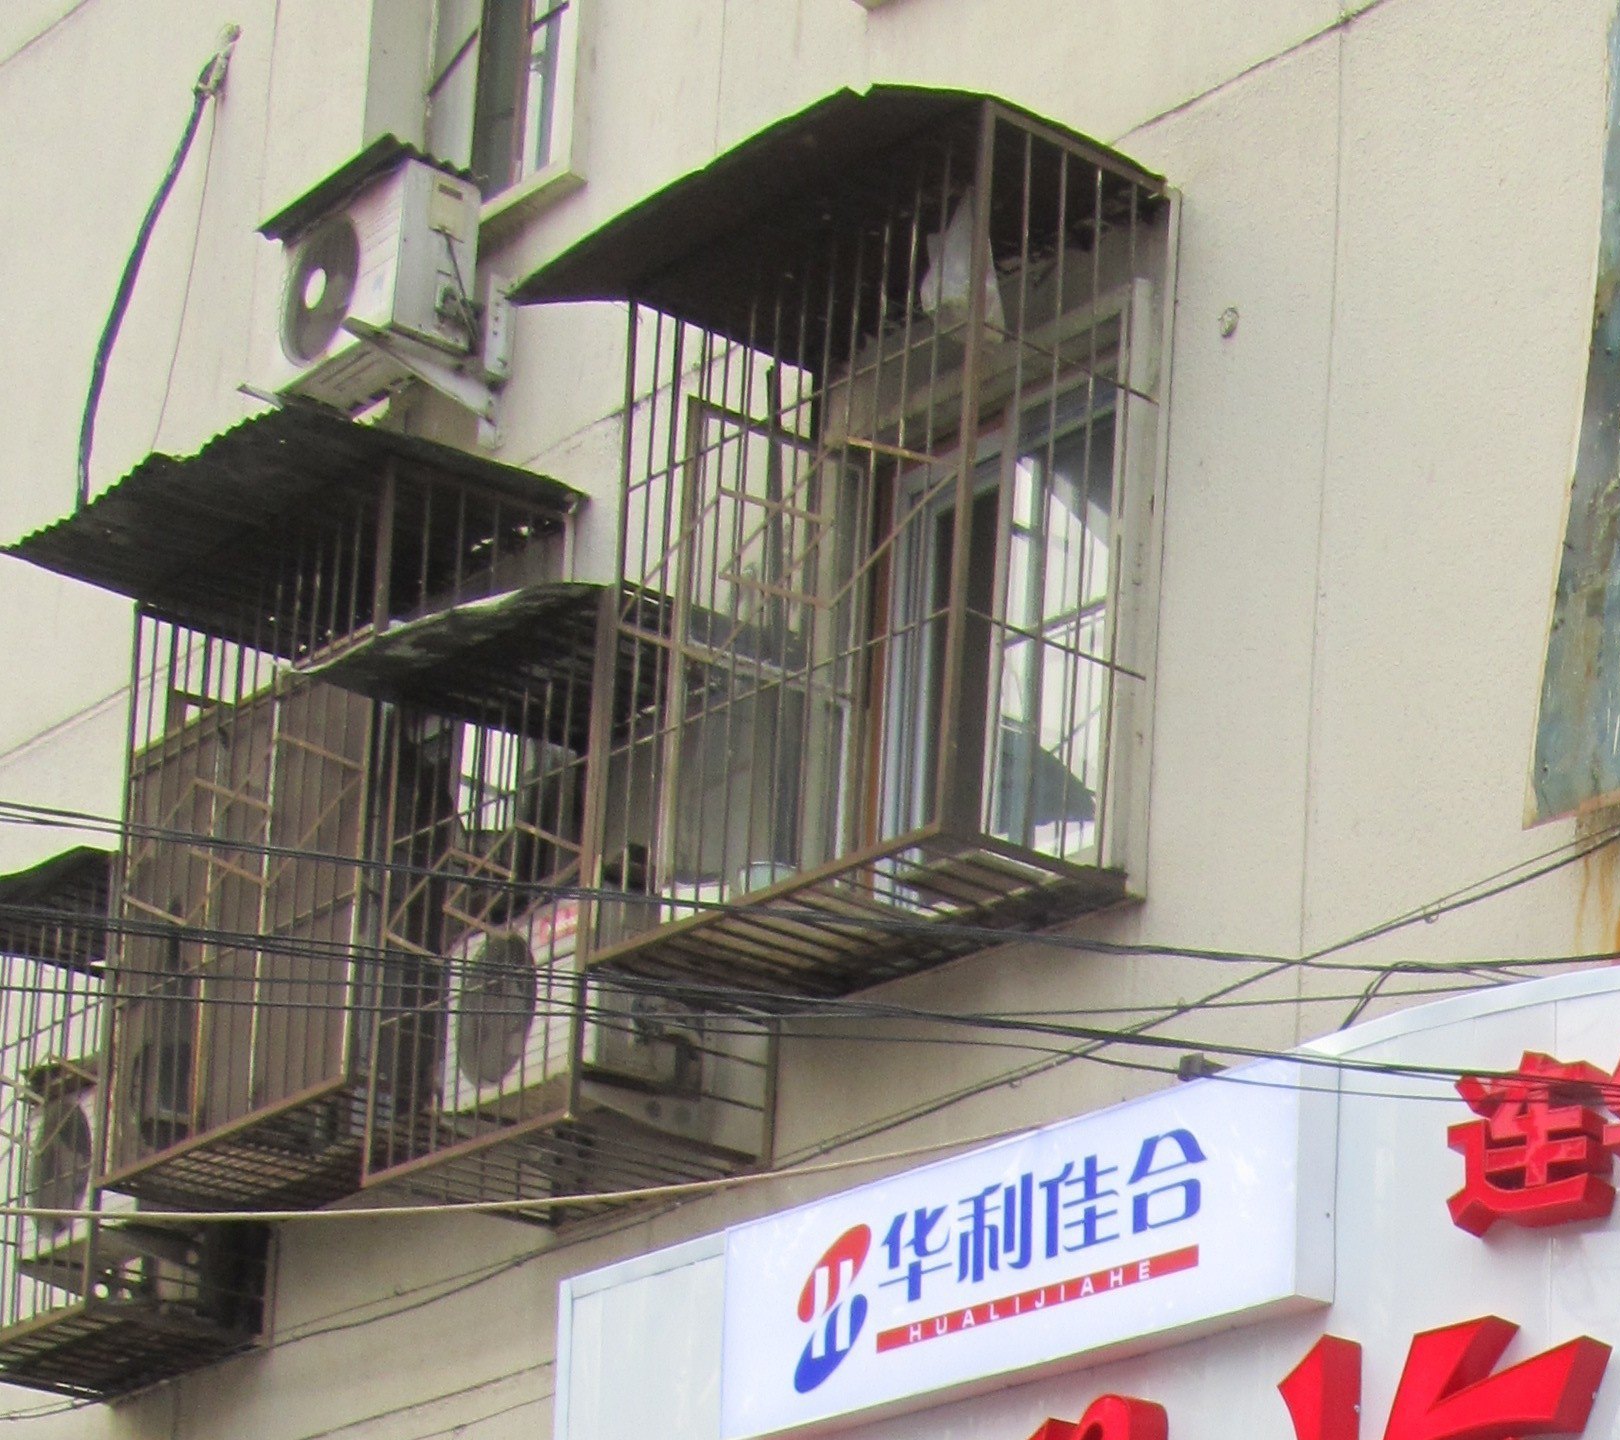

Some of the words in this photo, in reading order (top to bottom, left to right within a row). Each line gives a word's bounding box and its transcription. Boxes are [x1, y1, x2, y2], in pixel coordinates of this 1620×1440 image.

[878, 1127, 1208, 1303] 华利佳合
[908, 1259, 1152, 1343] HUALIJIAHE
